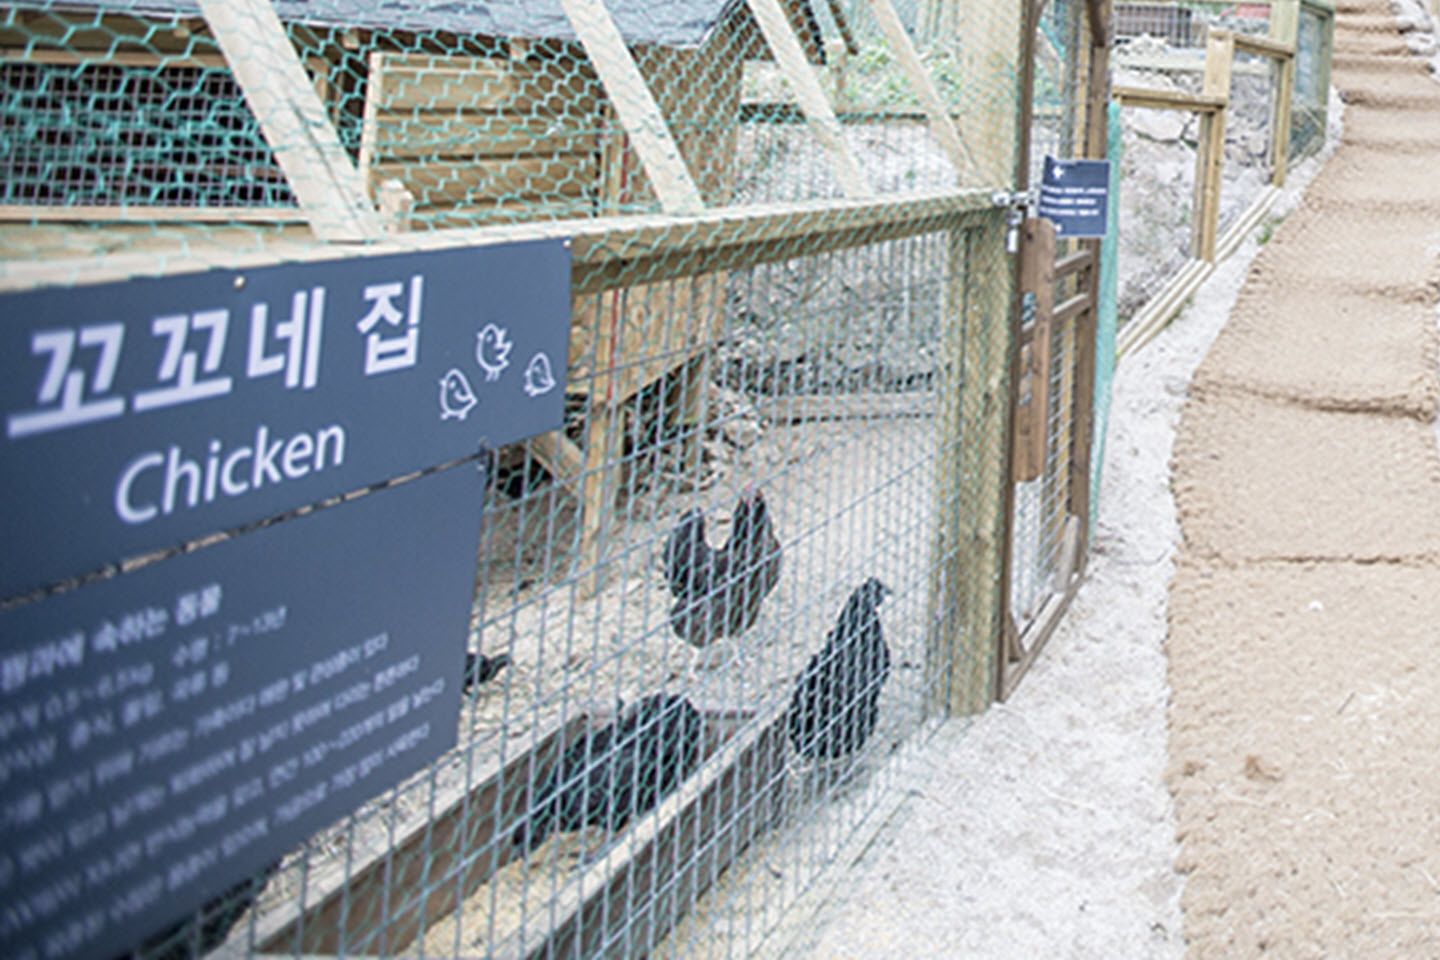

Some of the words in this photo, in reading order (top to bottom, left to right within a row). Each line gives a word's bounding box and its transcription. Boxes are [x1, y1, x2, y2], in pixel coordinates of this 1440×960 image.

[8, 286, 325, 439] 꼬꼬네
[356, 274, 423, 376] 집
[114, 424, 345, 525] Chicken
